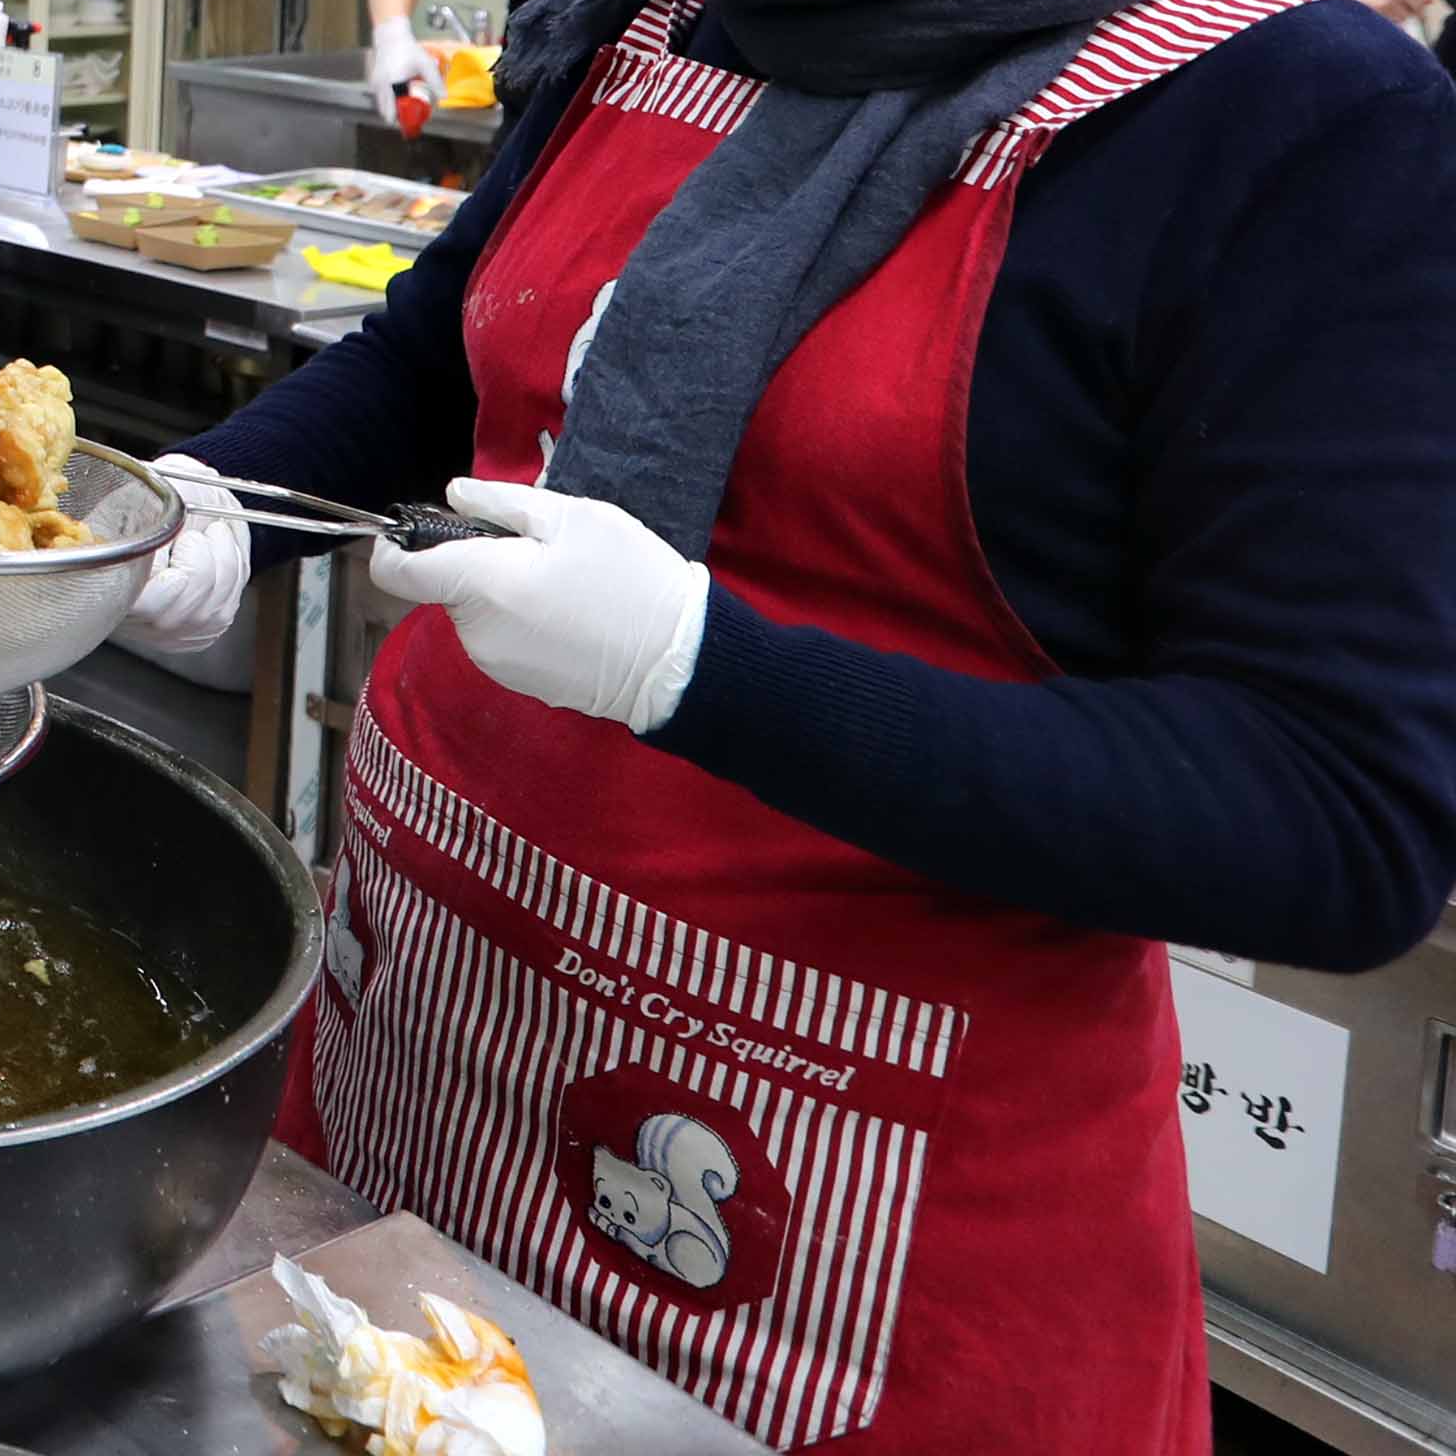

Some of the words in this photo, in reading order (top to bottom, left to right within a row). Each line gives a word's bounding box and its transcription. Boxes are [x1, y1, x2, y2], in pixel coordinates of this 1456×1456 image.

[553, 947, 636, 1005] Don't
[639, 992, 704, 1039] Cry
[706, 1021, 857, 1091] Squirrel
